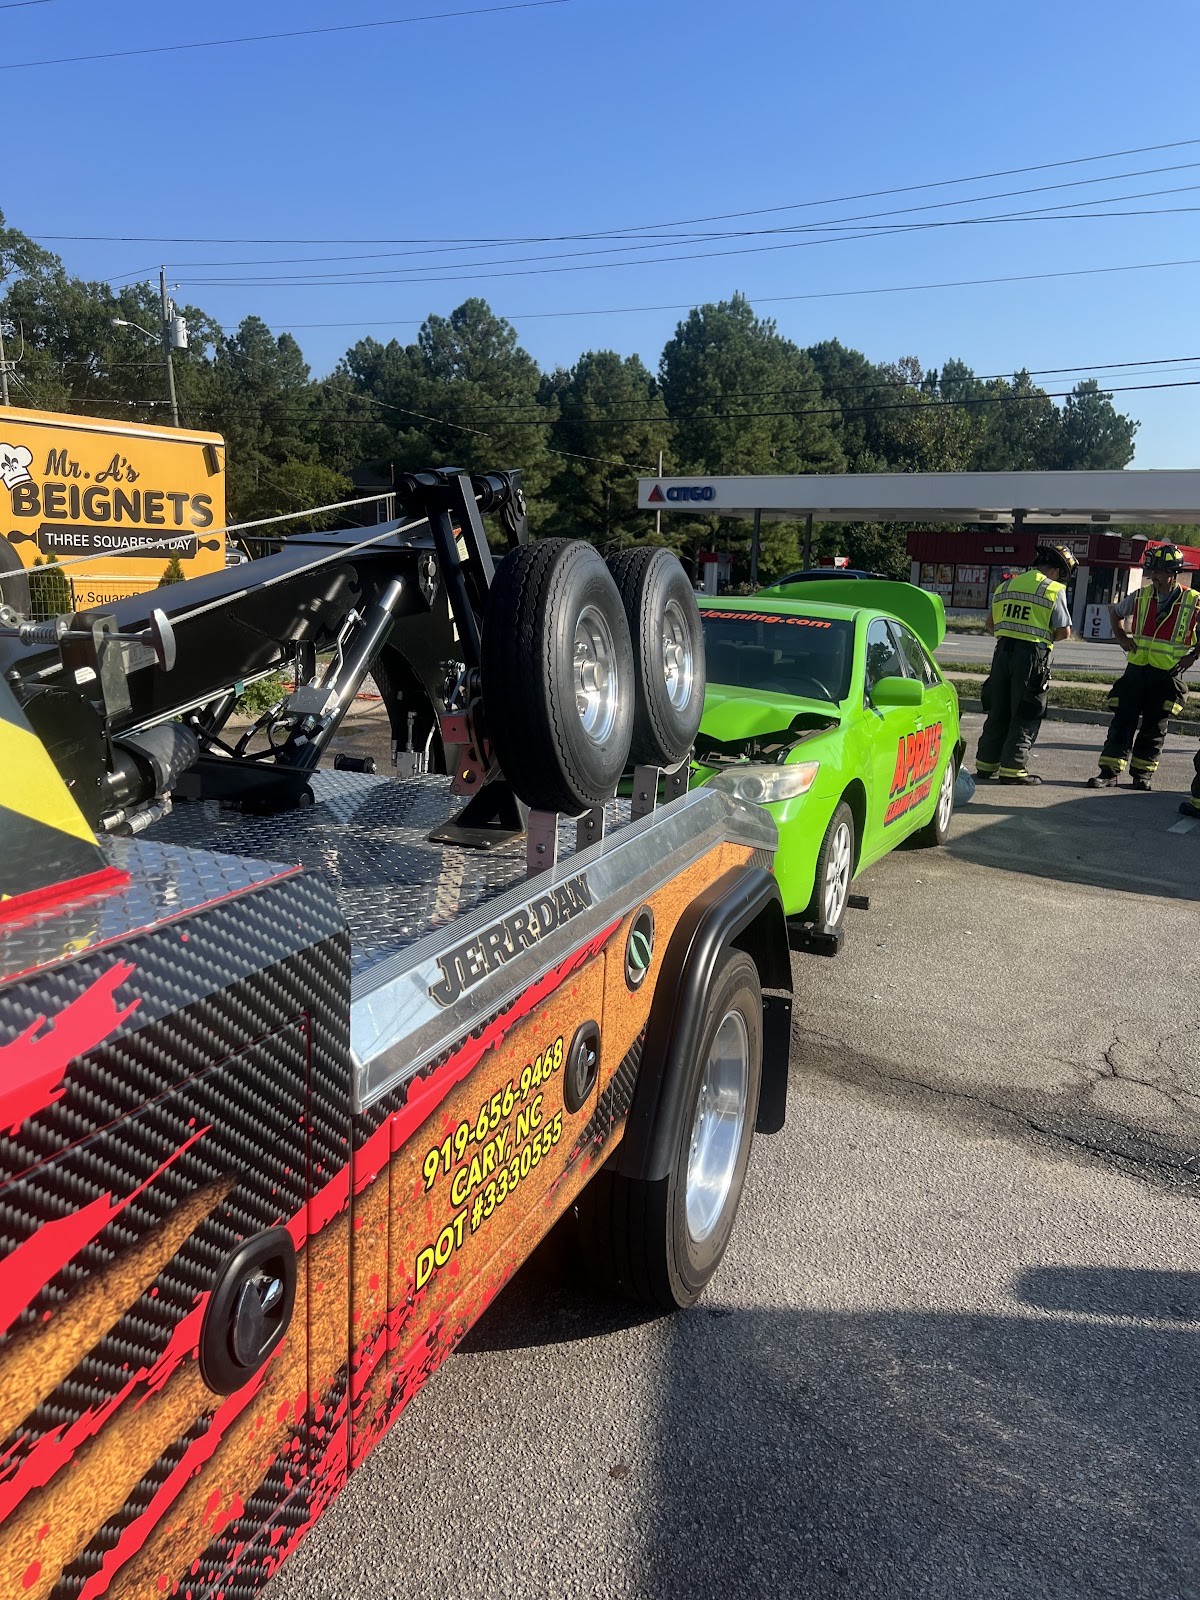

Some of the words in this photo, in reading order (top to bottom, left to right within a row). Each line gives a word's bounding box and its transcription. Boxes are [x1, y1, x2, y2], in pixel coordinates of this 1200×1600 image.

[43, 448, 91, 479] Mr.
[94, 453, 140, 483] A's
[11, 481, 214, 527] BEIGNETS
[666, 486, 716, 502] CITGO
[45, 533, 90, 547] THREE
[93, 535, 154, 549] SQUARES
[169, 539, 192, 550] DAY
[958, 568, 987, 583] VAPE
[1002, 603, 1031, 620] FIRE
[422, 1035, 564, 1194] 919-656-9468
[450, 1123, 513, 1209] CARY,
[515, 1092, 544, 1146] NC
[415, 1205, 468, 1294] DOT
[470, 1108, 563, 1235] #3330555
